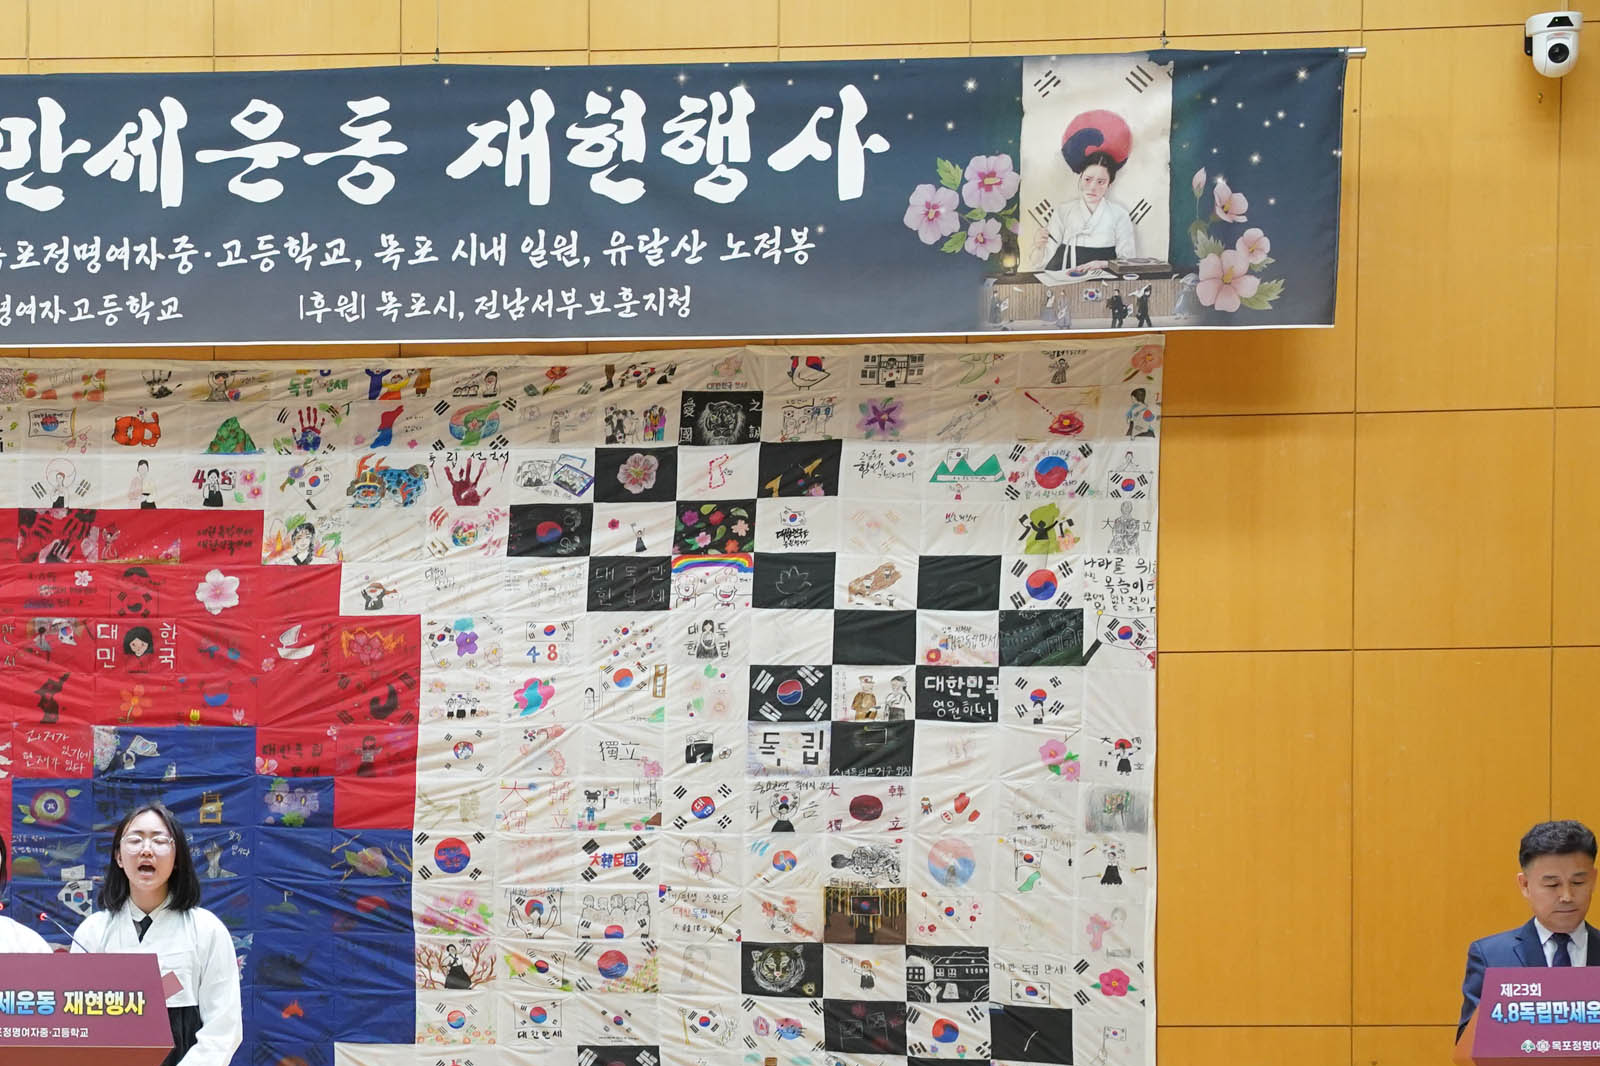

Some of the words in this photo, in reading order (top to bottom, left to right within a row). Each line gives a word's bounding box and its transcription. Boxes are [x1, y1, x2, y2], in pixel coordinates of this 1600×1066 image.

[446, 84, 891, 206] 재현행사
[374, 232, 439, 270] 목포
[451, 232, 507, 266] 시내
[521, 229, 590, 268] 일원,
[602, 228, 707, 266] 유달산
[720, 227, 816, 264] 노적봉
[376, 289, 465, 321] 목포시,
[475, 285, 692, 323] 전남서부보훈지청
[190, 469, 205, 490] 4
[526, 645, 539, 664] 4
[547, 643, 558, 662] 8
[1500, 983, 1542, 997] 제23회
[63, 991, 146, 1016] 재현행사
